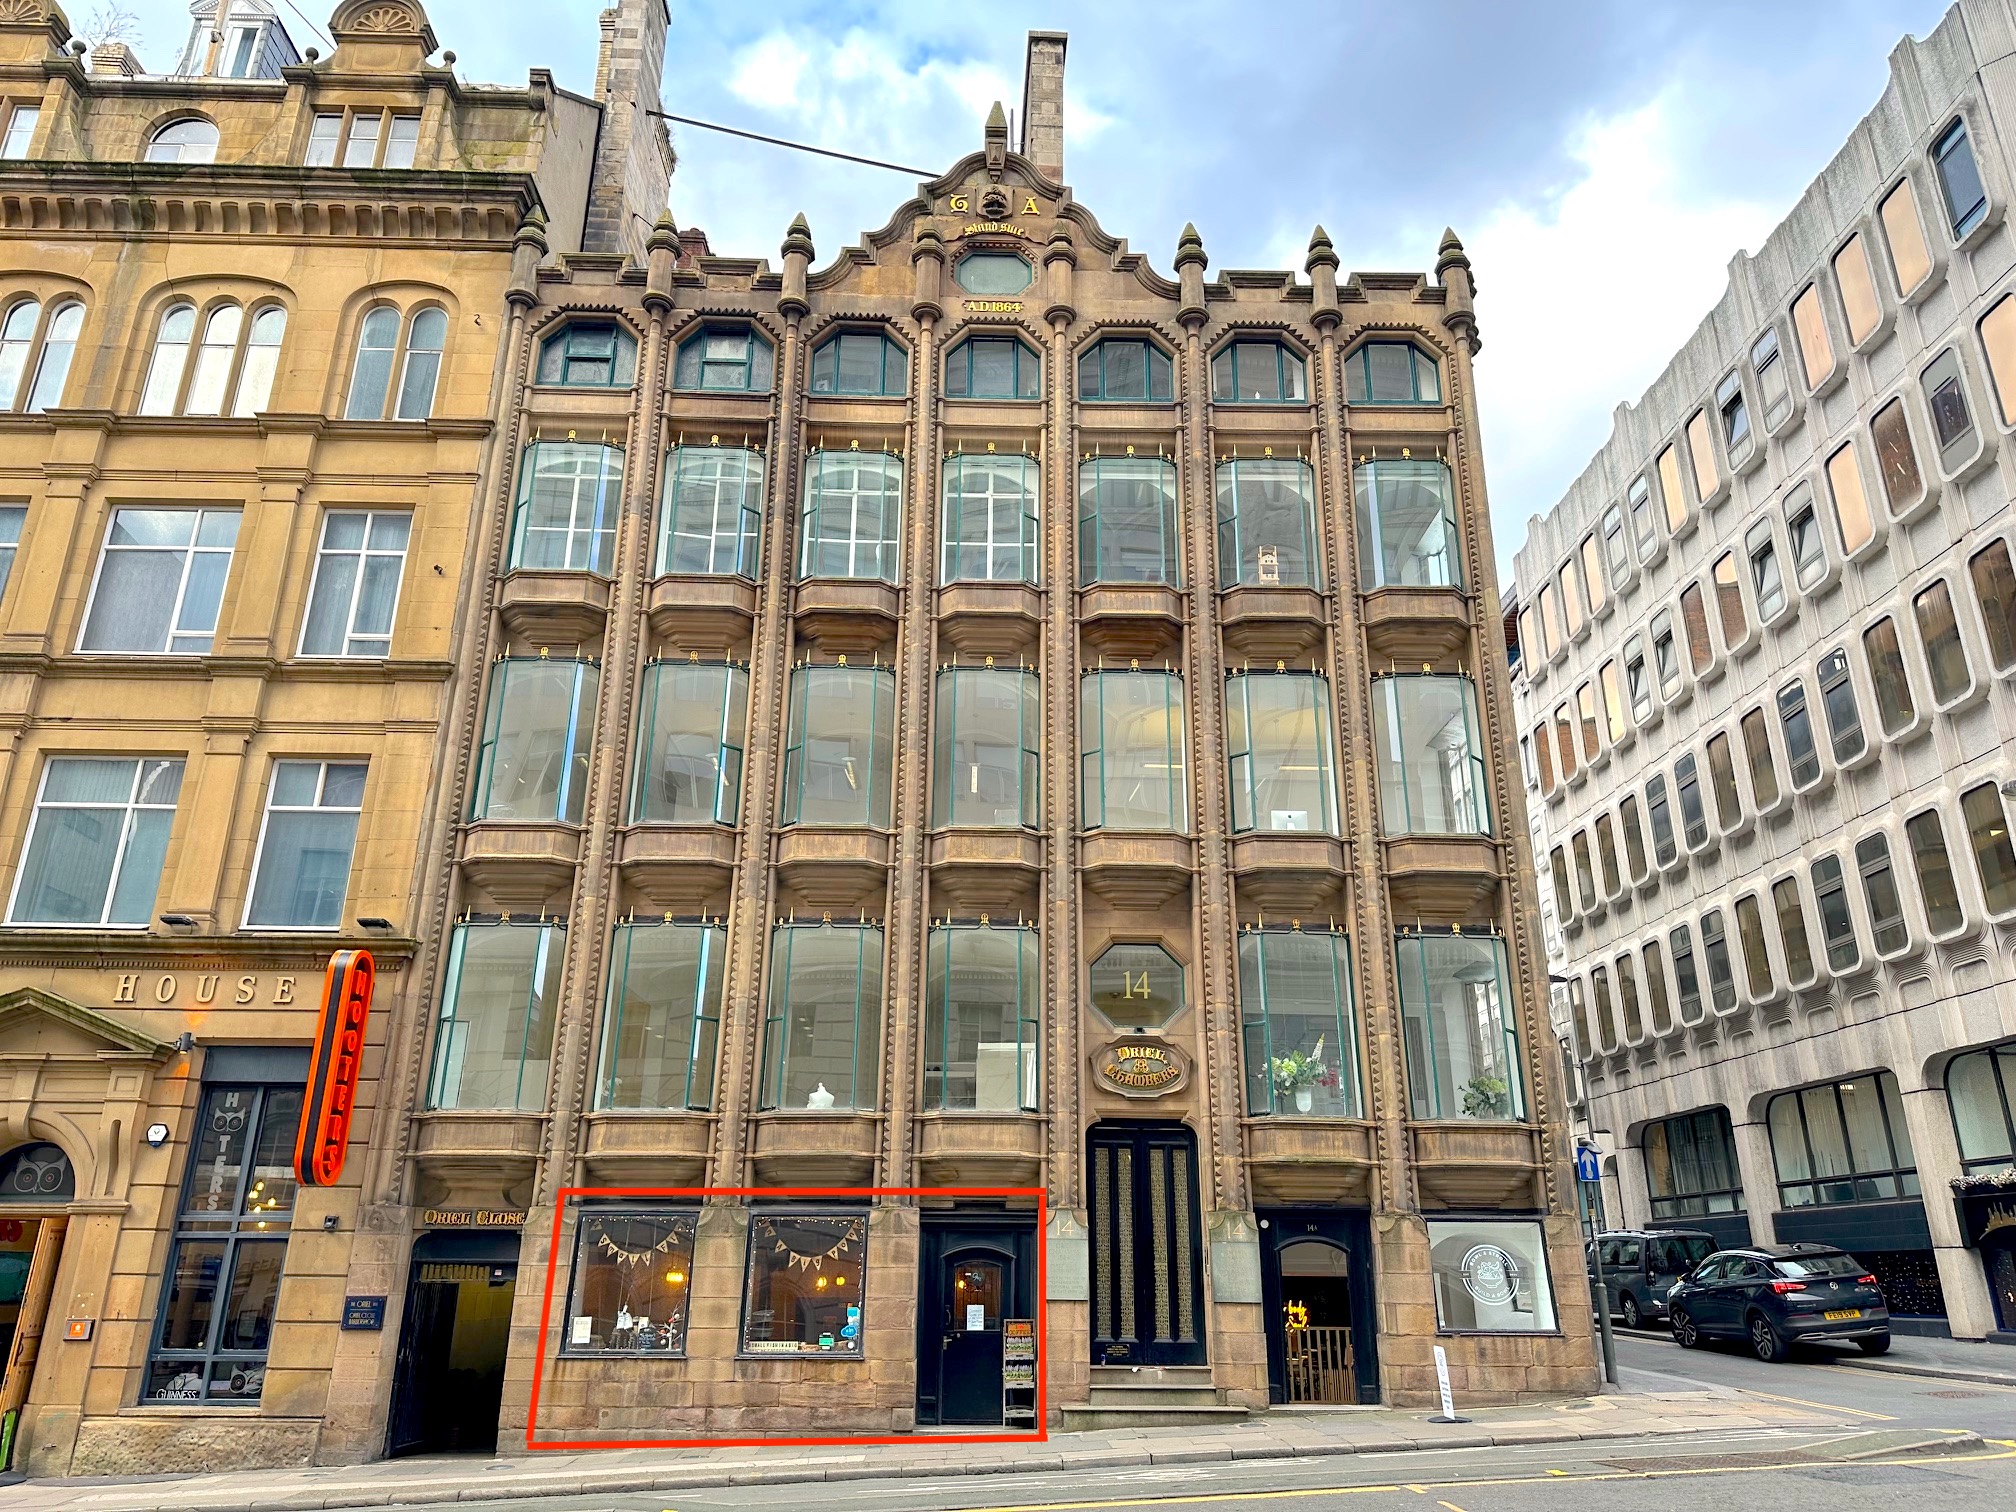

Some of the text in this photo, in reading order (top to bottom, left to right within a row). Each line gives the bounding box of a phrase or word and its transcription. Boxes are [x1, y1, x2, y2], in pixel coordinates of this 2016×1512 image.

[965, 221, 1025, 236] Stand sure
[113, 974, 297, 1004] HOUSE
[1122, 970, 1152, 999] 14
[324, 969, 367, 1172] HOOTERS
[1056, 1219, 1074, 1236] 14
[1226, 1221, 1246, 1239] 14
[1475, 1286, 1490, 1297] BUILD
[1828, 1310, 1856, 1319] FE19 SVP
[156, 1388, 197, 1400] GUINNESS
